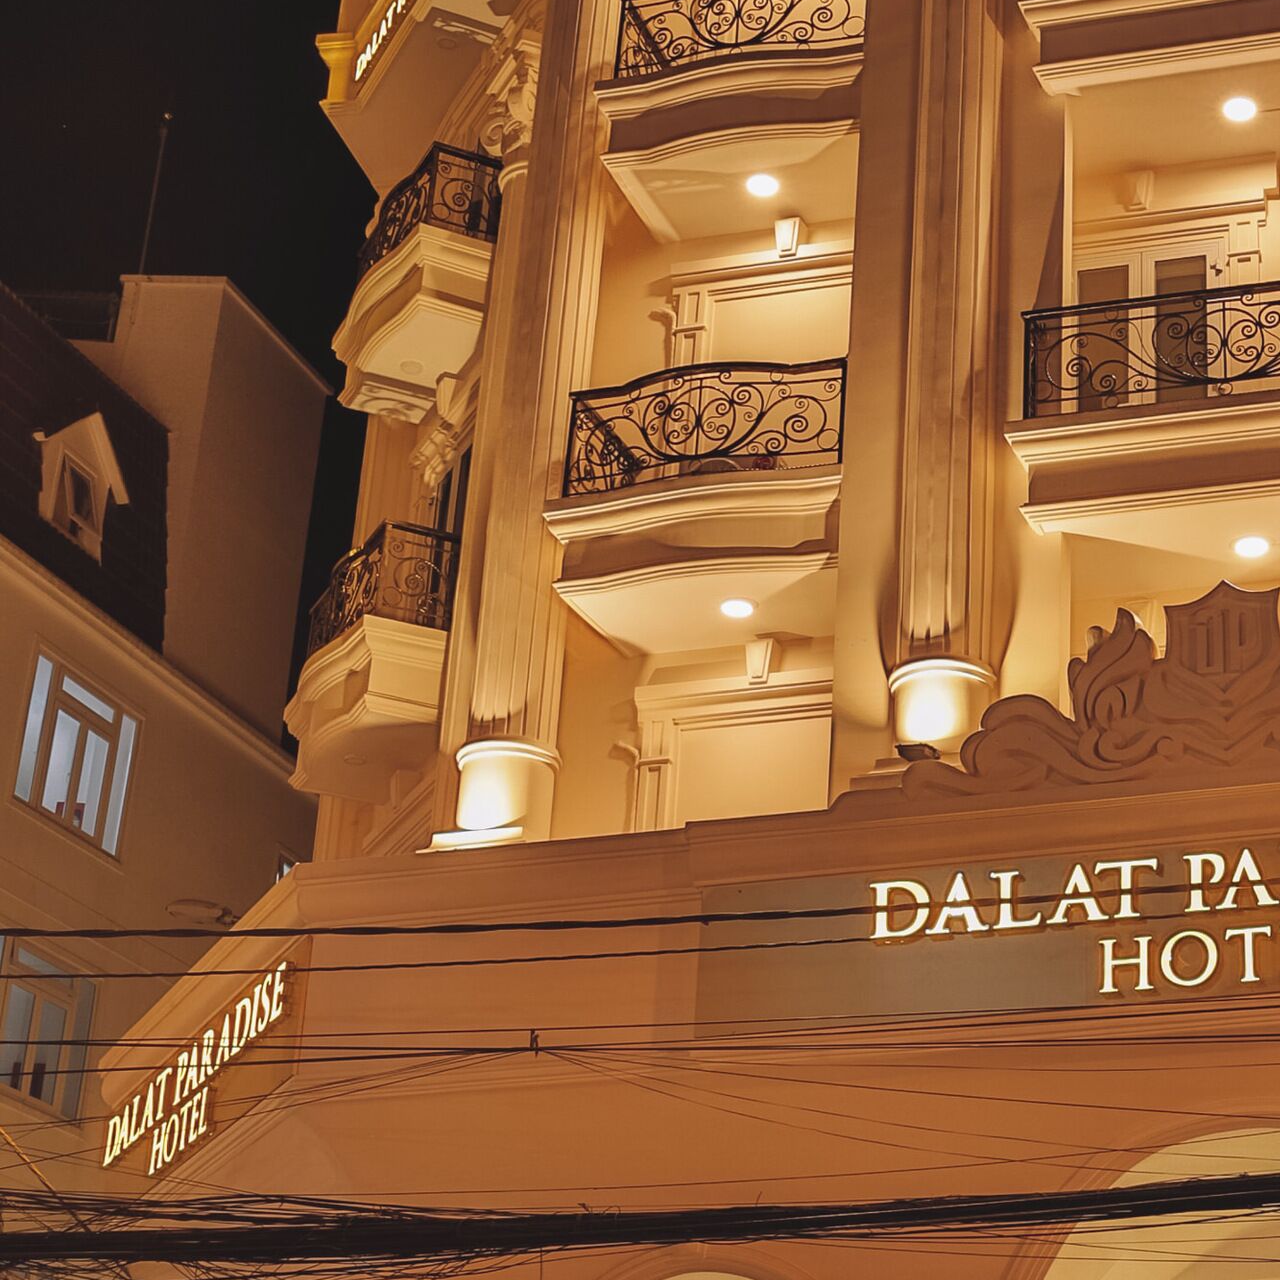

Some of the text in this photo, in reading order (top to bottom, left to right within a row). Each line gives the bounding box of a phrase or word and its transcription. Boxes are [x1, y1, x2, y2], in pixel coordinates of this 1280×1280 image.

[868, 857, 1159, 940] DALAT
[102, 960, 287, 1168] DALAT PARADISE
[148, 1086, 209, 1176] HOTEL
